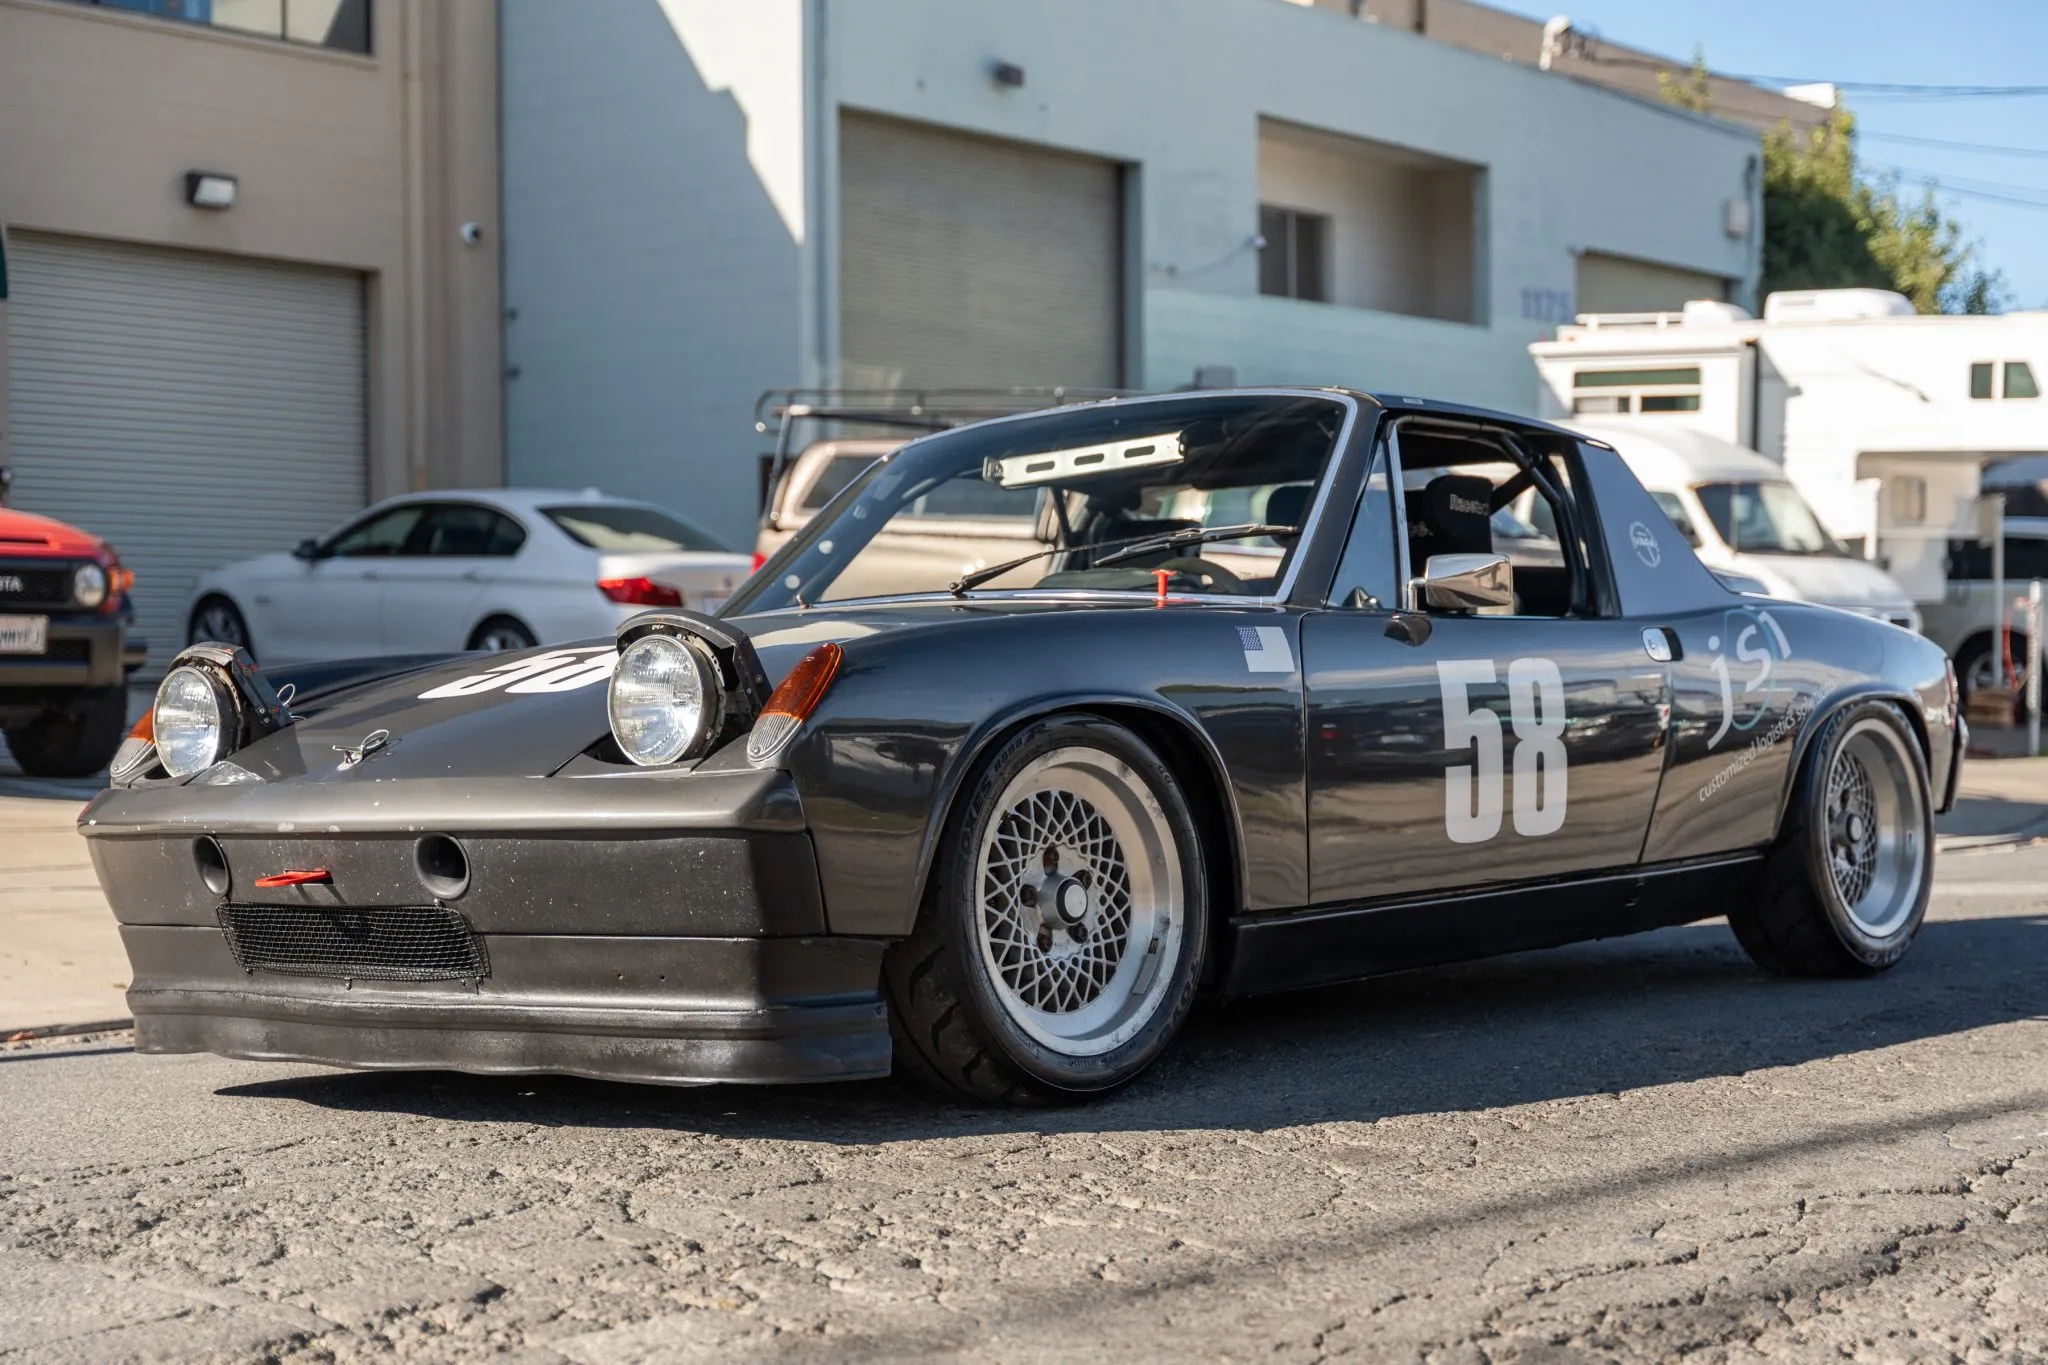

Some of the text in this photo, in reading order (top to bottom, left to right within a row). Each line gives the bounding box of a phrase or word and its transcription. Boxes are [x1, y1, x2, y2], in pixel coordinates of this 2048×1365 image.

[1436, 657, 1568, 844] 58
[1699, 741, 1757, 802] customized
[1756, 708, 1796, 755] logistics
